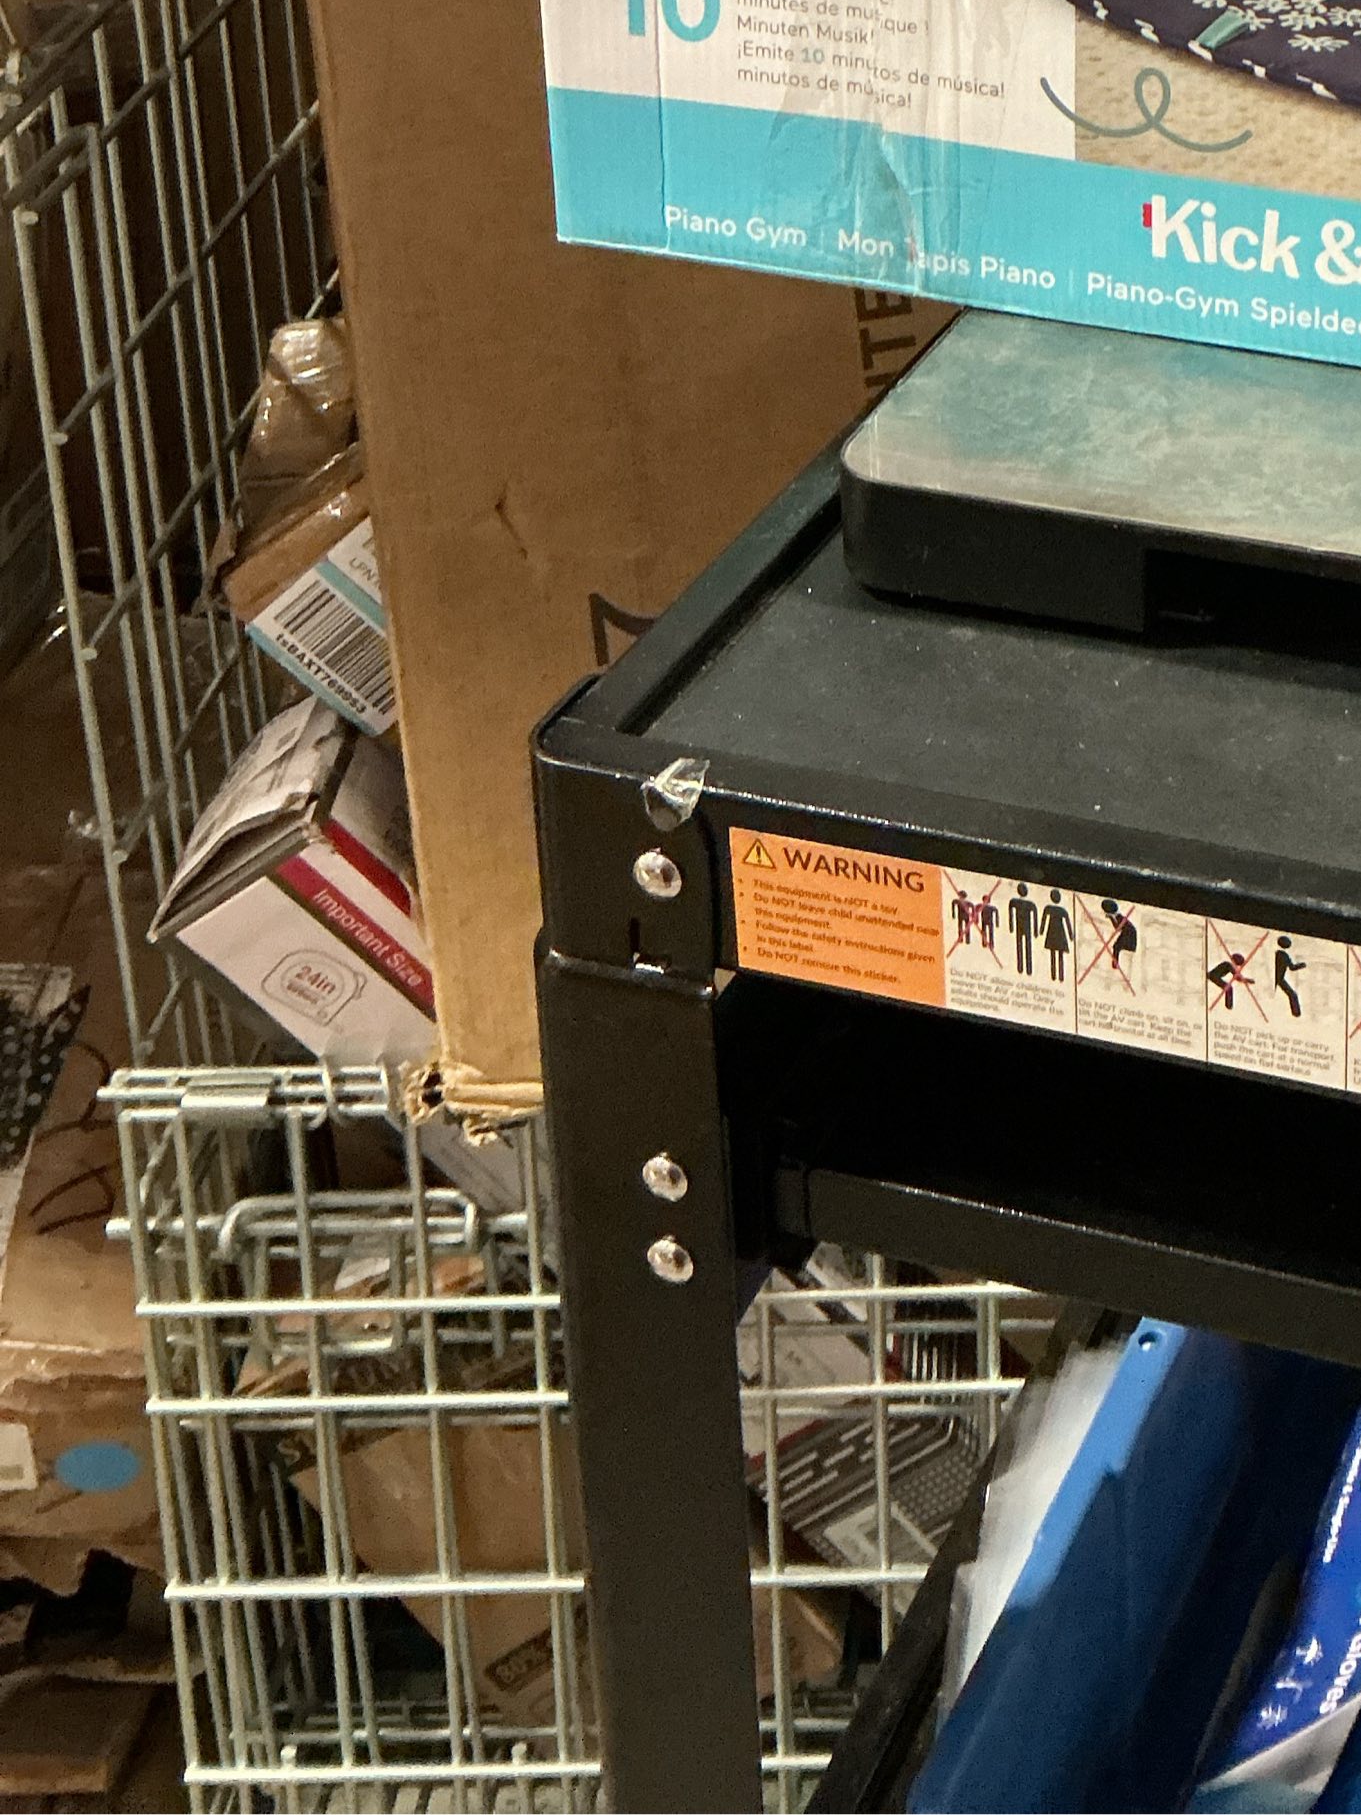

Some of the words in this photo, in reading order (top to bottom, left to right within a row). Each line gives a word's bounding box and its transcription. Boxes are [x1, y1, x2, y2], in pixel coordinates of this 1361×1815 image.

[737, 15, 809, 36] Minuten
[816, 24, 874, 44] Musik!
[816, 1, 839, 16] de
[737, 68, 810, 88] minutos
[816, 75, 840, 91] de
[801, 48, 824, 64] 10
[907, 69, 930, 84] de
[937, 75, 1005, 98] música!
[1151, 194, 1302, 279] Kick
[664, 204, 737, 239] Piano
[746, 216, 808, 249] Gym
[838, 228, 894, 259] Mon
[980, 256, 1056, 290] Piano
[1086, 271, 1239, 318] Piano-Gym
[351, 557, 375, 582] LPN
[783, 847, 925, 894] WARNING
[314, 888, 389, 960] Important
[384, 950, 424, 988] Size
